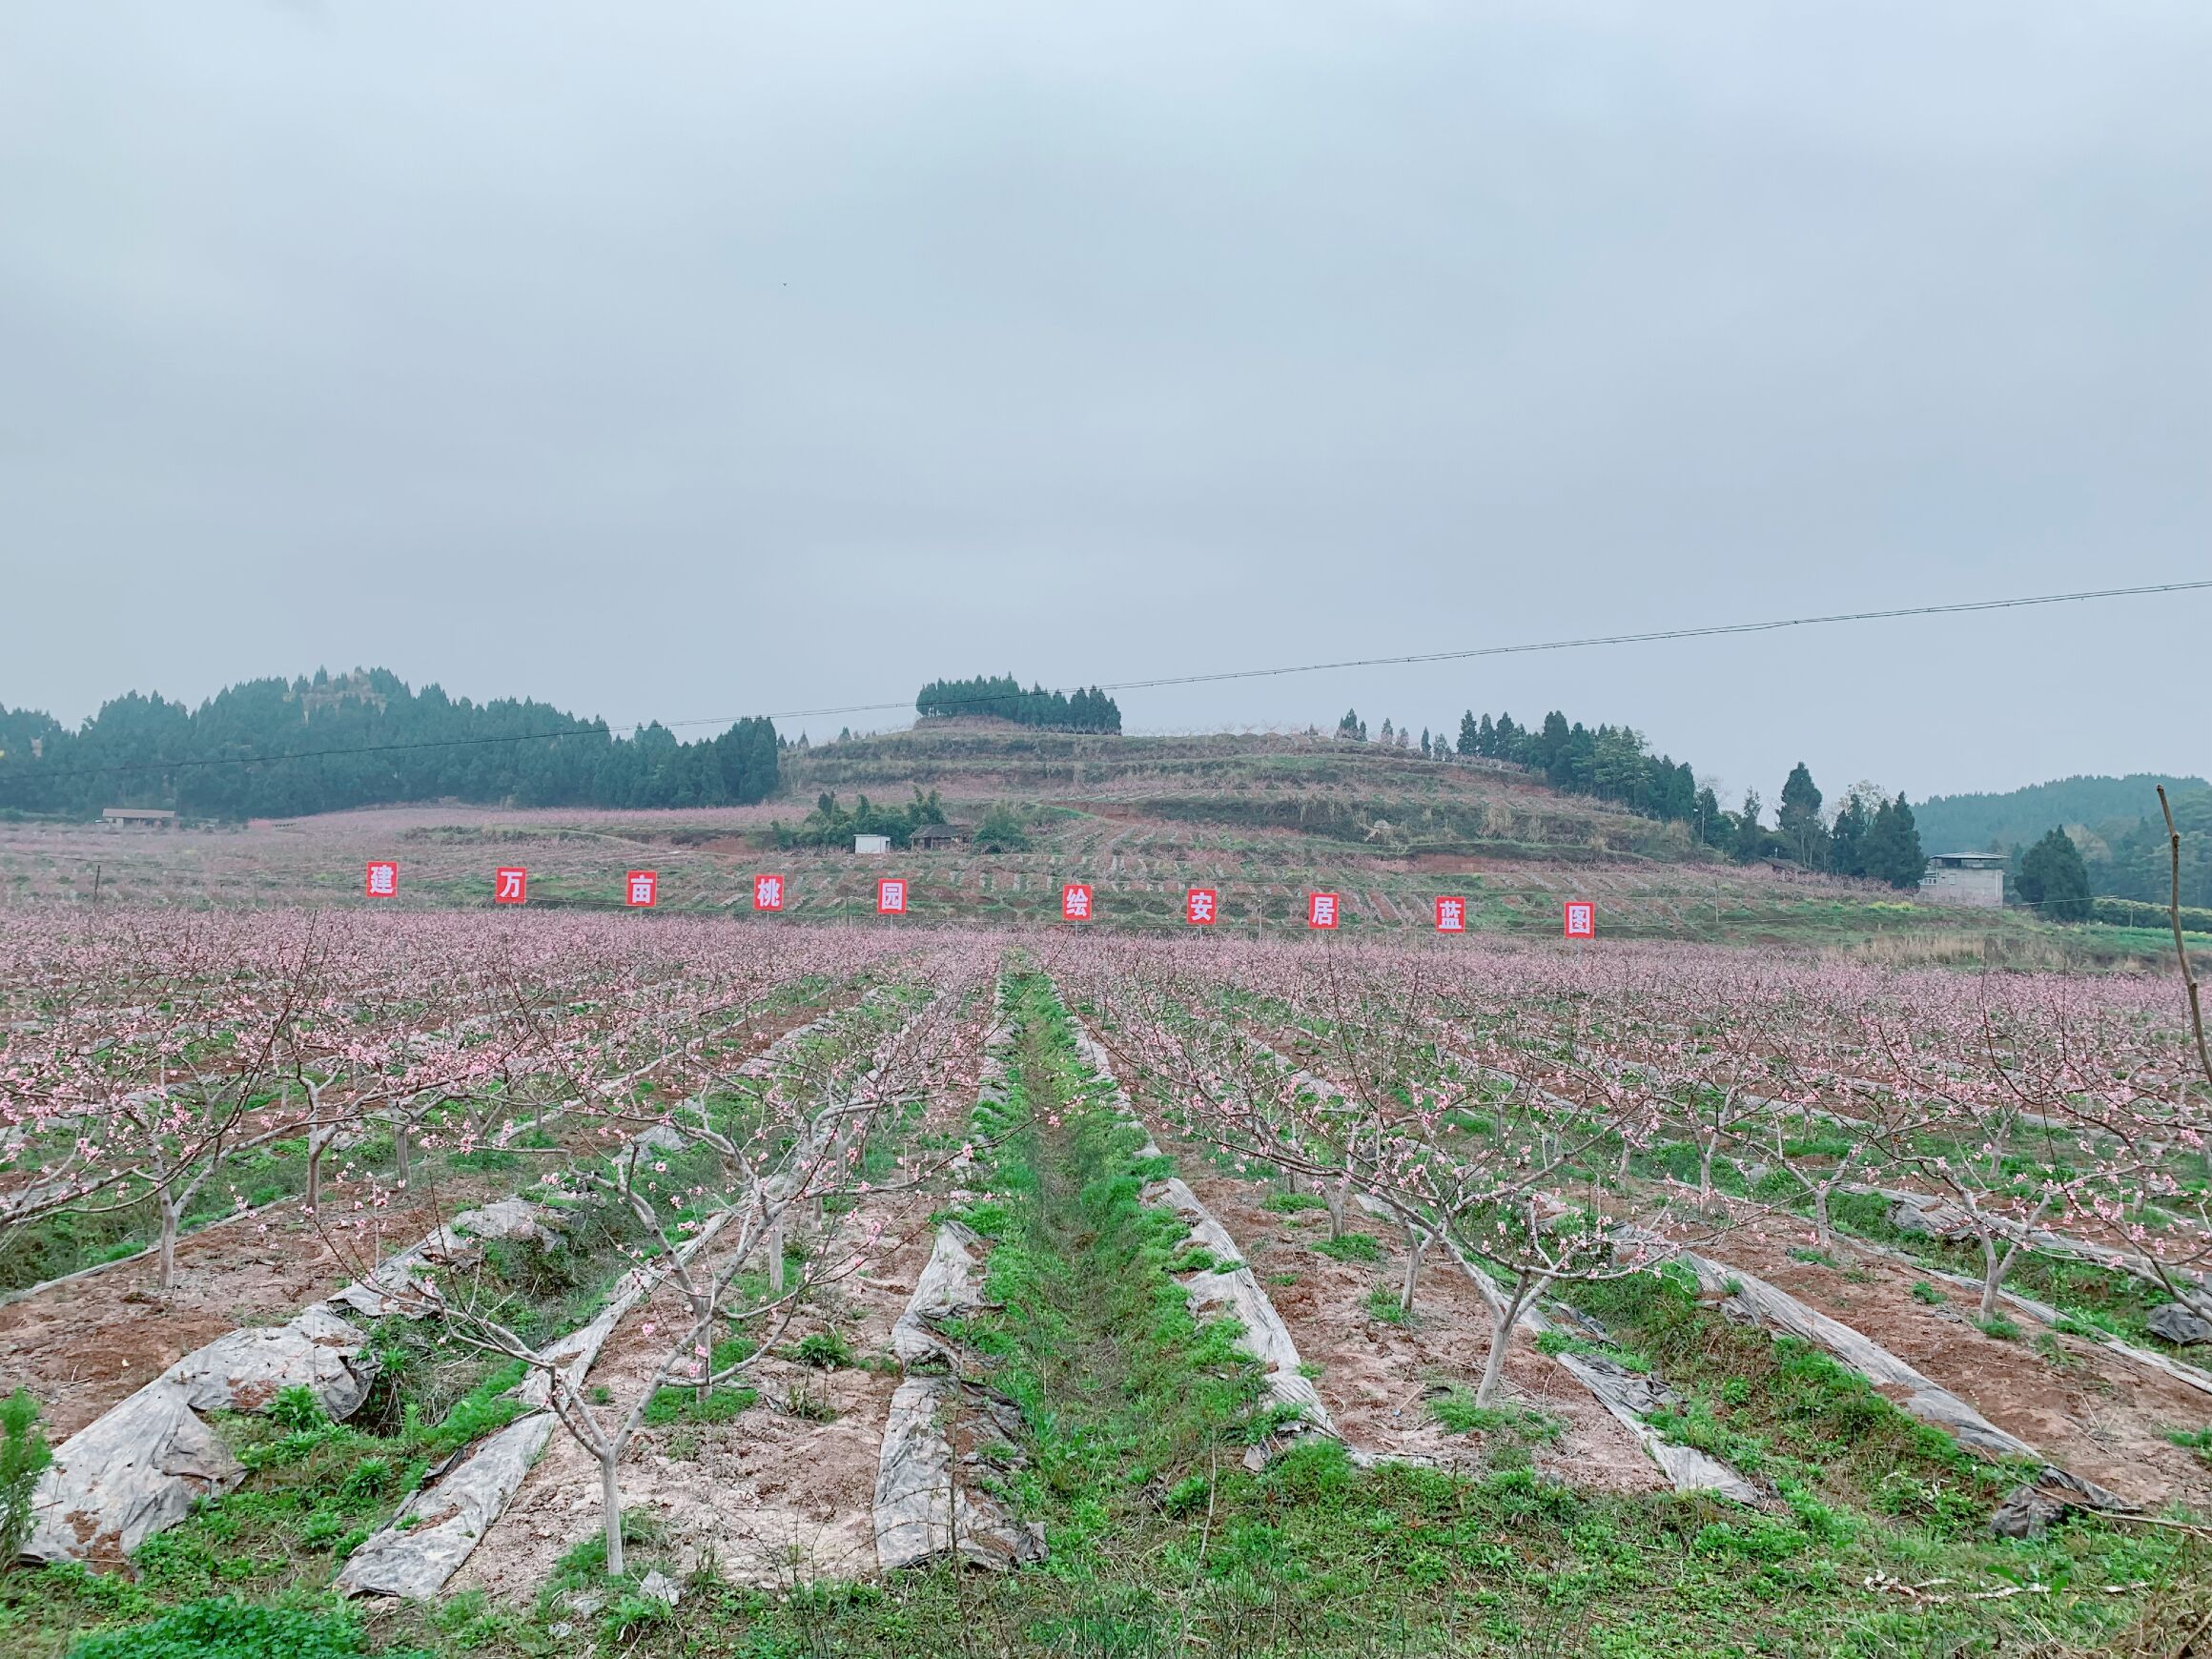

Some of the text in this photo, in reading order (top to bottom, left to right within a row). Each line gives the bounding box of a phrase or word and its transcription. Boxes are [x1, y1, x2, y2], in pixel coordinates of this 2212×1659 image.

[370, 865, 1590, 934] 建 万 亩 桃 园 绘 安 居 蓝 图
